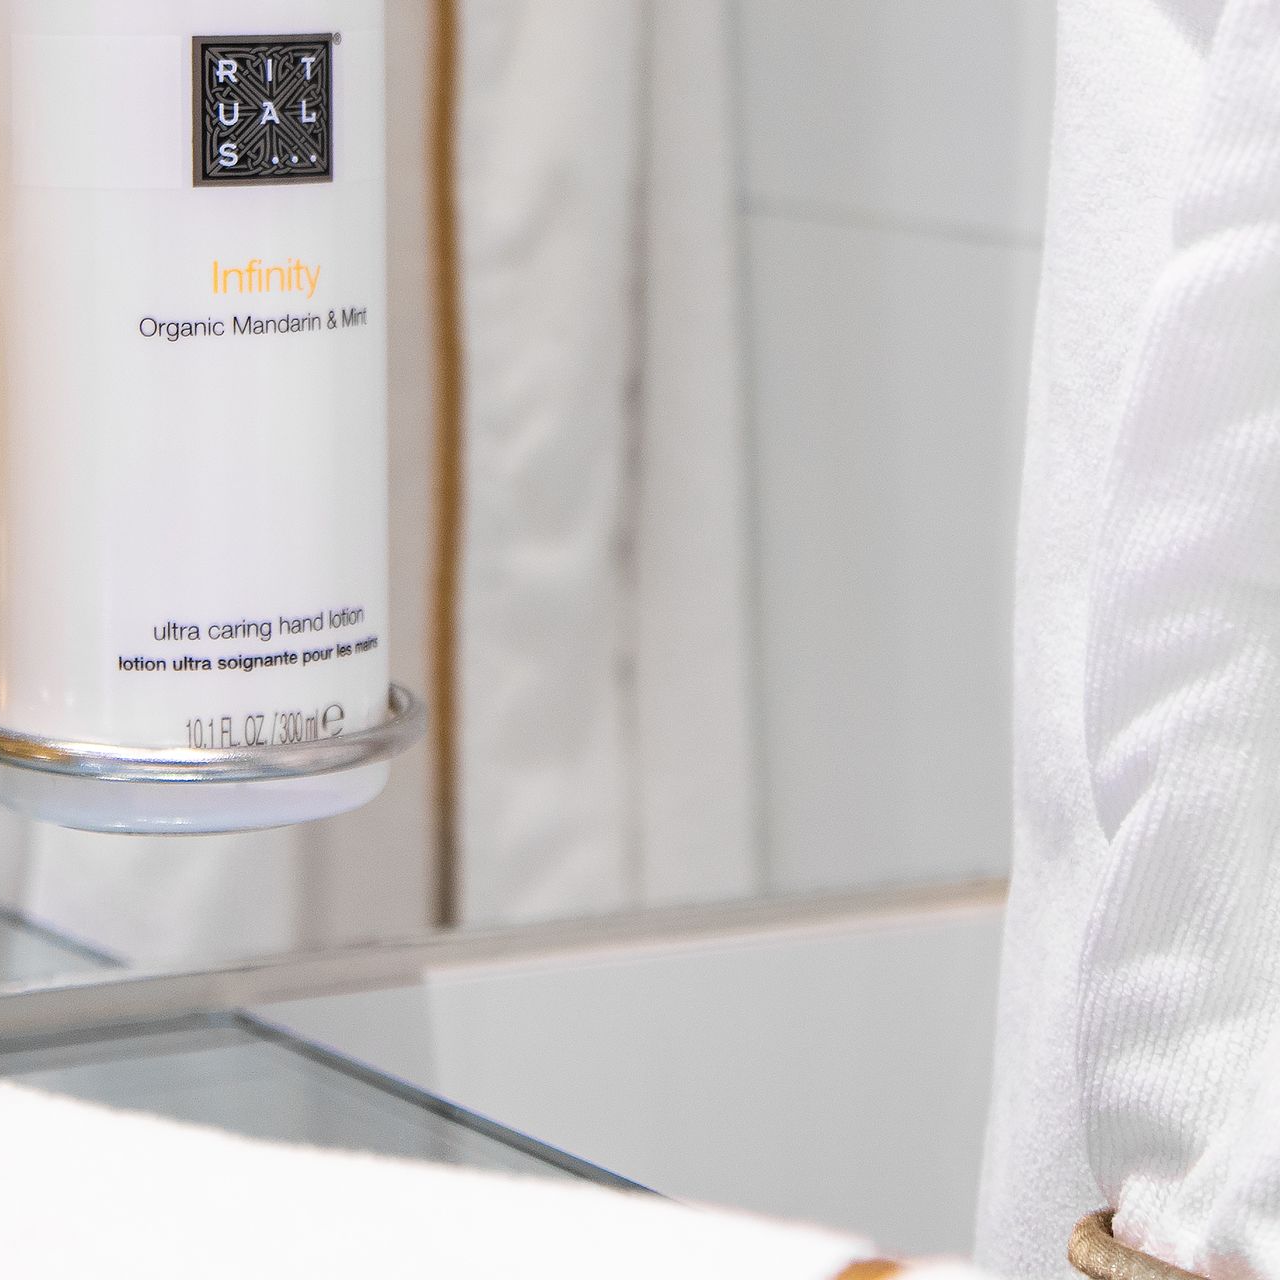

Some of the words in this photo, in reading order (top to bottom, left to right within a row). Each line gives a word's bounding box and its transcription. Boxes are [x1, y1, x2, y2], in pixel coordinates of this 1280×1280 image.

[216, 57, 316, 83] RIT
[219, 100, 317, 126] UAL
[212, 258, 321, 299] Infinity
[139, 317, 225, 342] Organic
[233, 312, 322, 336] Mandarin
[327, 310, 338, 330] &
[342, 307, 368, 328] Mint
[153, 621, 201, 642] ultra
[208, 619, 272, 643] caring
[279, 612, 323, 636] hand
[328, 606, 364, 630] lotion
[119, 656, 167, 672] lotion
[172, 655, 212, 671] ultra
[217, 651, 298, 673] soignante
[302, 647, 335, 667] pour
[336, 644, 352, 658] les
[186, 719, 214, 749] 10.1
[244, 715, 268, 746] OZ.
